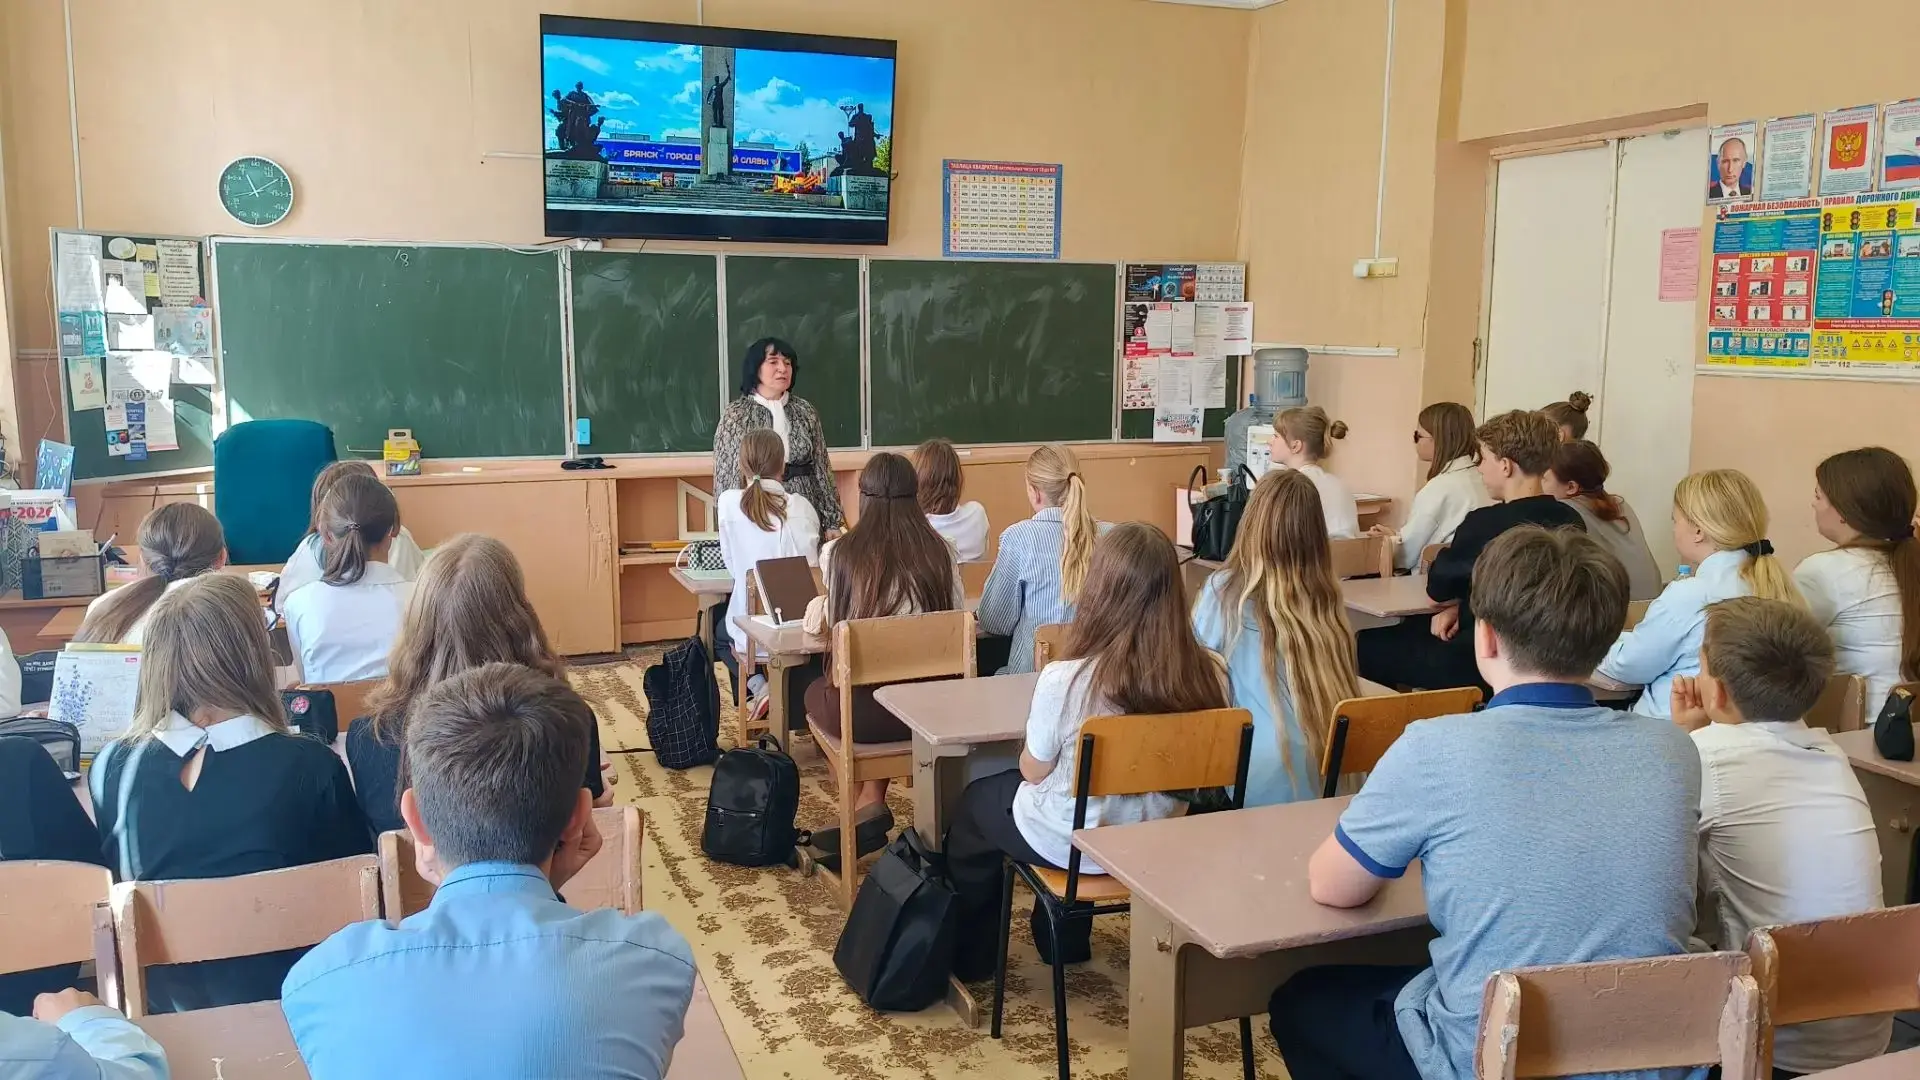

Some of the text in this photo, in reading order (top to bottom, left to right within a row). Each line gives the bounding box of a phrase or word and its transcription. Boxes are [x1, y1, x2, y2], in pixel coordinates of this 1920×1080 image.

[623, 149, 658, 159] БРЯНСК
[665, 152, 693, 161] ГОРОД
[1823, 196, 1855, 206] ПРАВИЛА
[1855, 191, 1899, 205] ДОРОЖНОГО
[1730, 199, 1820, 213] ПОЖАРНАЯ БЕЗОПАСНОСТЬ
